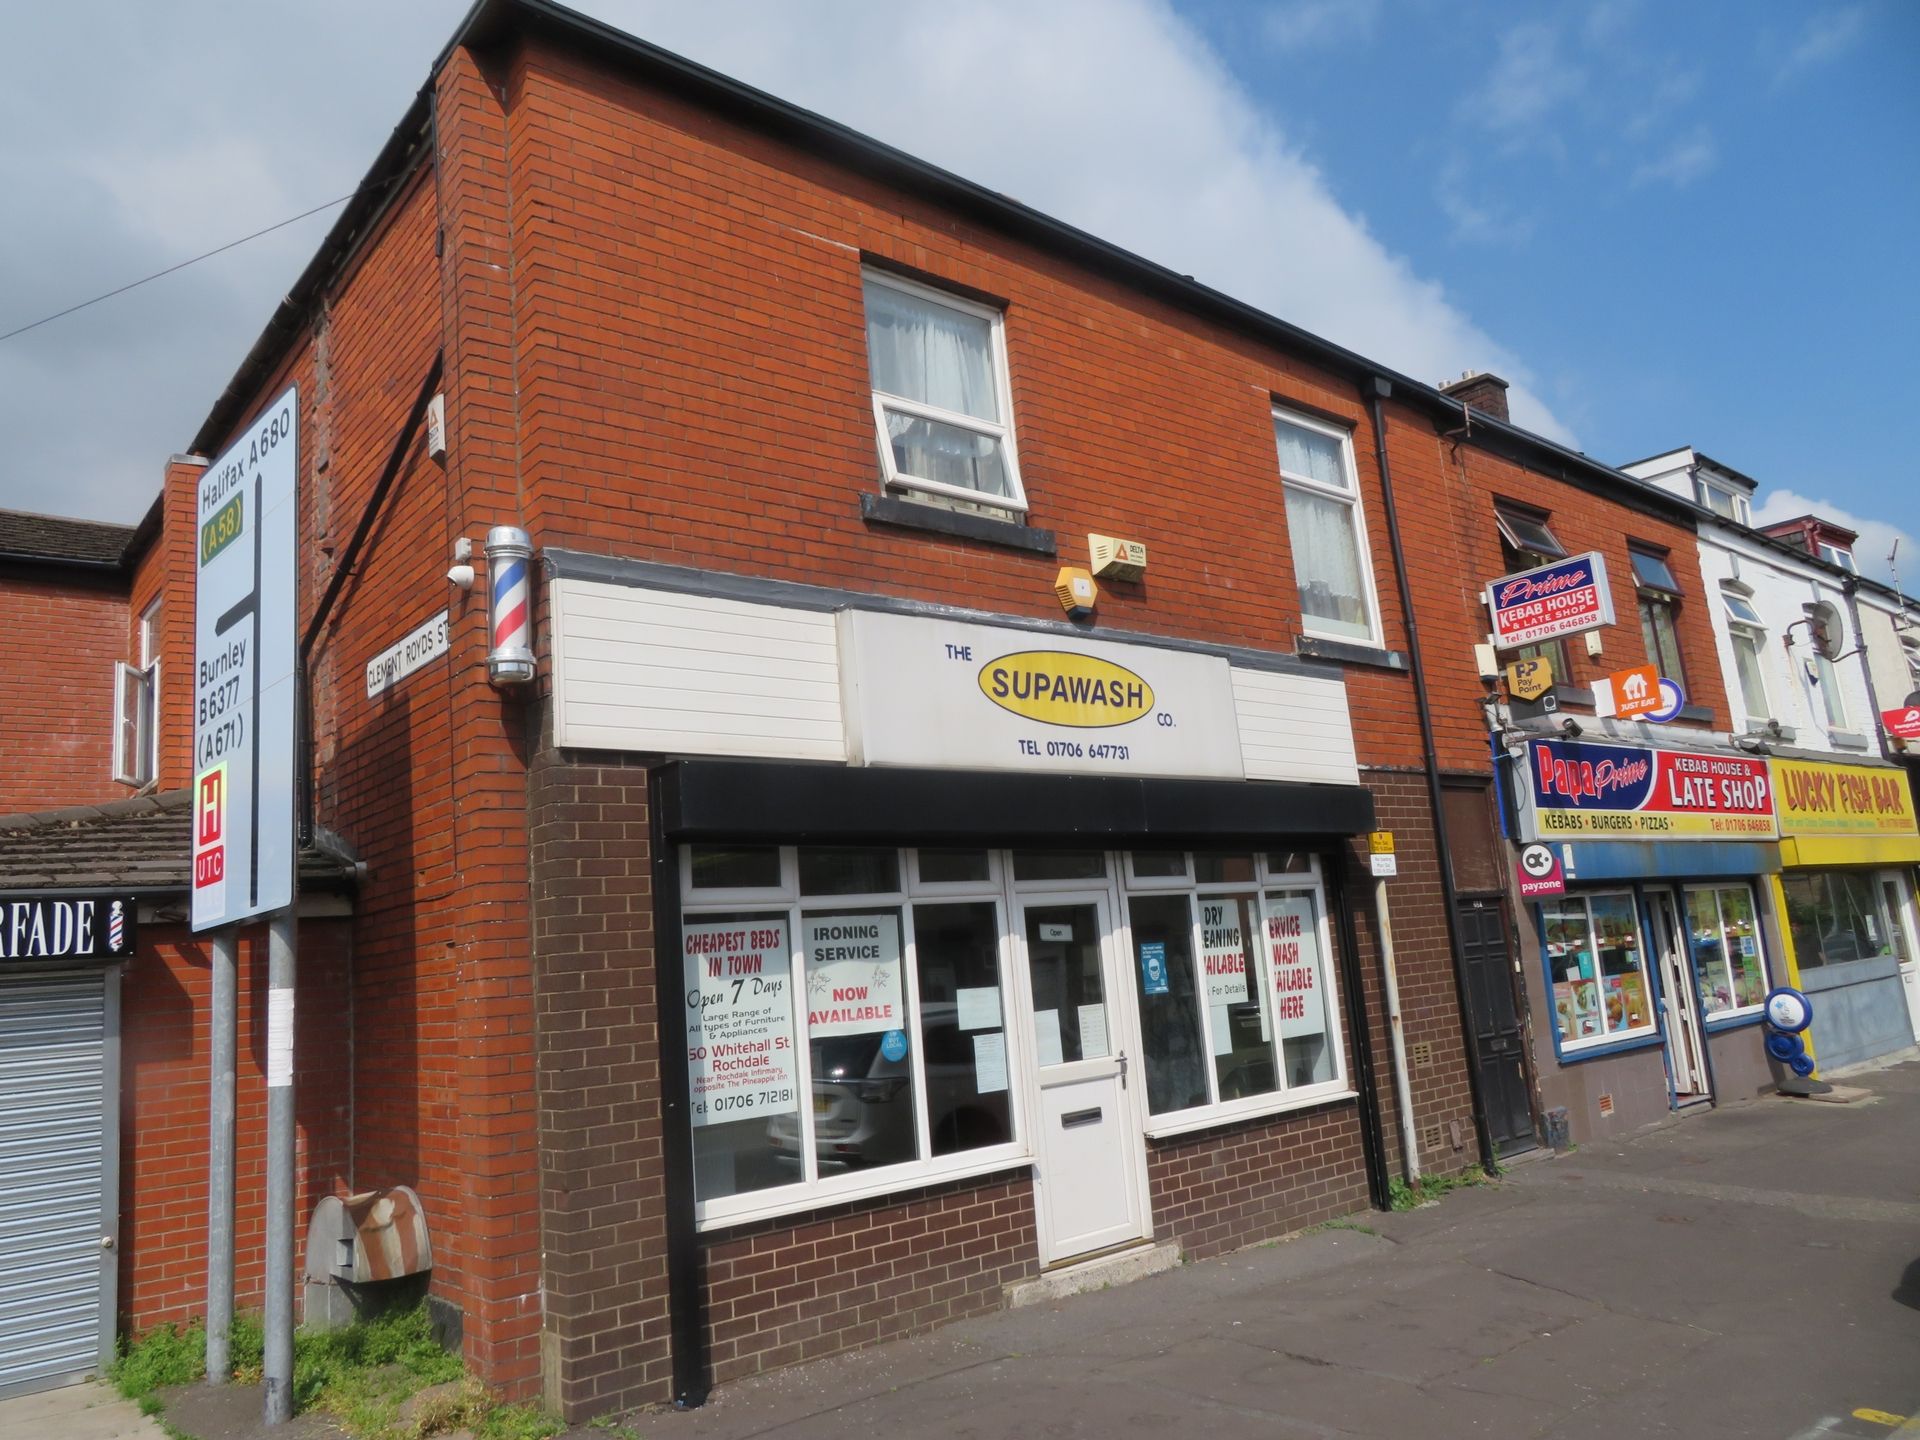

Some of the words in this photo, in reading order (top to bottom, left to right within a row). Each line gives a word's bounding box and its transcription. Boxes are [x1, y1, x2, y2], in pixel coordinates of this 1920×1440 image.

[202, 457, 244, 514] Halifax
[1129, 544, 1144, 554] DELTA
[1500, 570, 1586, 607] Prime
[1500, 603, 1543, 628] KEBAB
[1547, 589, 1594, 611] HOUSE
[1513, 622, 1519, 630] &
[1524, 614, 1552, 626] LATE
[1555, 605, 1586, 618] SHOP
[1505, 634, 1522, 643] Tel:
[1526, 625, 1556, 639] 01706
[1560, 614, 1597, 629] 646858
[200, 639, 247, 689] Burnley
[368, 650, 402, 688] CLEMENT
[406, 630, 433, 665] ROYDS
[945, 644, 972, 661] THE
[991, 668, 1143, 708] SUPAWASH
[1157, 713, 1177, 727] CO.
[1517, 678, 1533, 688] Pay
[1518, 684, 1542, 694] Point
[1621, 701, 1639, 712] JUST
[1641, 697, 1657, 707] EAT
[1018, 739, 1041, 755] TEL
[1047, 741, 1083, 758] 01706
[1088, 744, 1129, 760] 647731
[1536, 745, 1596, 806] Papa
[1594, 757, 1648, 800] Prime
[1675, 758, 1708, 773] KEBAB
[1710, 761, 1742, 776] HOUSE
[1744, 764, 1751, 776] &
[1668, 768, 1717, 807] LATE
[1721, 776, 1766, 810] SHOP
[1781, 768, 1835, 812] LUCKY
[1836, 773, 1874, 814] FISH
[1871, 775, 1904, 815] BAR
[1544, 814, 1583, 829] KEBABS
[1591, 815, 1632, 830] BURGERS
[1640, 817, 1668, 830] PIZZAS
[1710, 818, 1723, 831] Tel:
[1725, 819, 1747, 832] 01706
[1747, 820, 1771, 832] 646858
[198, 854, 222, 881] UTC
[1522, 880, 1561, 893] payzone
[1204, 906, 1223, 926] DRY
[686, 931, 746, 954] CHEAPEST
[750, 928, 780, 950] BEDS
[813, 925, 879, 941] IRONING
[1203, 928, 1239, 949] EANING
[814, 945, 880, 961] SERVICE
[1272, 942, 1299, 965] WASH
[709, 957, 722, 977] IN
[727, 954, 762, 975] TOWN
[1204, 953, 1245, 975] AILABLE
[1212, 986, 1223, 995] For
[1225, 984, 1246, 994] Details
[1275, 967, 1313, 992] AILABLE
[687, 989, 723, 1014] Open
[731, 979, 745, 1005] 7
[750, 977, 782, 997] Days
[832, 987, 868, 1001] NOW
[703, 1013, 729, 1022] Large
[732, 1009, 760, 1019] Range
[763, 1007, 772, 1015] of
[808, 1005, 893, 1025] AVAILABLE
[1280, 995, 1304, 1020] HERE
[688, 1025, 701, 1033] All
[704, 1022, 729, 1032] types
[733, 1019, 742, 1027] of
[745, 1015, 785, 1026] Furniture
[709, 1032, 716, 1040] &
[720, 1026, 768, 1039] Appliances
[689, 1047, 707, 1061] 50
[712, 1038, 771, 1057] Whitehall
[775, 1036, 790, 1050] St
[713, 1054, 770, 1072] Rochdale
[693, 1083, 725, 1093] opposite
[728, 1080, 740, 1088] The
[742, 1076, 775, 1086] Pineapple
[777, 1073, 788, 1081] Inn
[696, 1075, 714, 1084] Near
[716, 1071, 749, 1081] Rochdale
[751, 1066, 783, 1076] Infirmary
[714, 1094, 754, 1111] 01706
[759, 1089, 793, 1105] 712181
